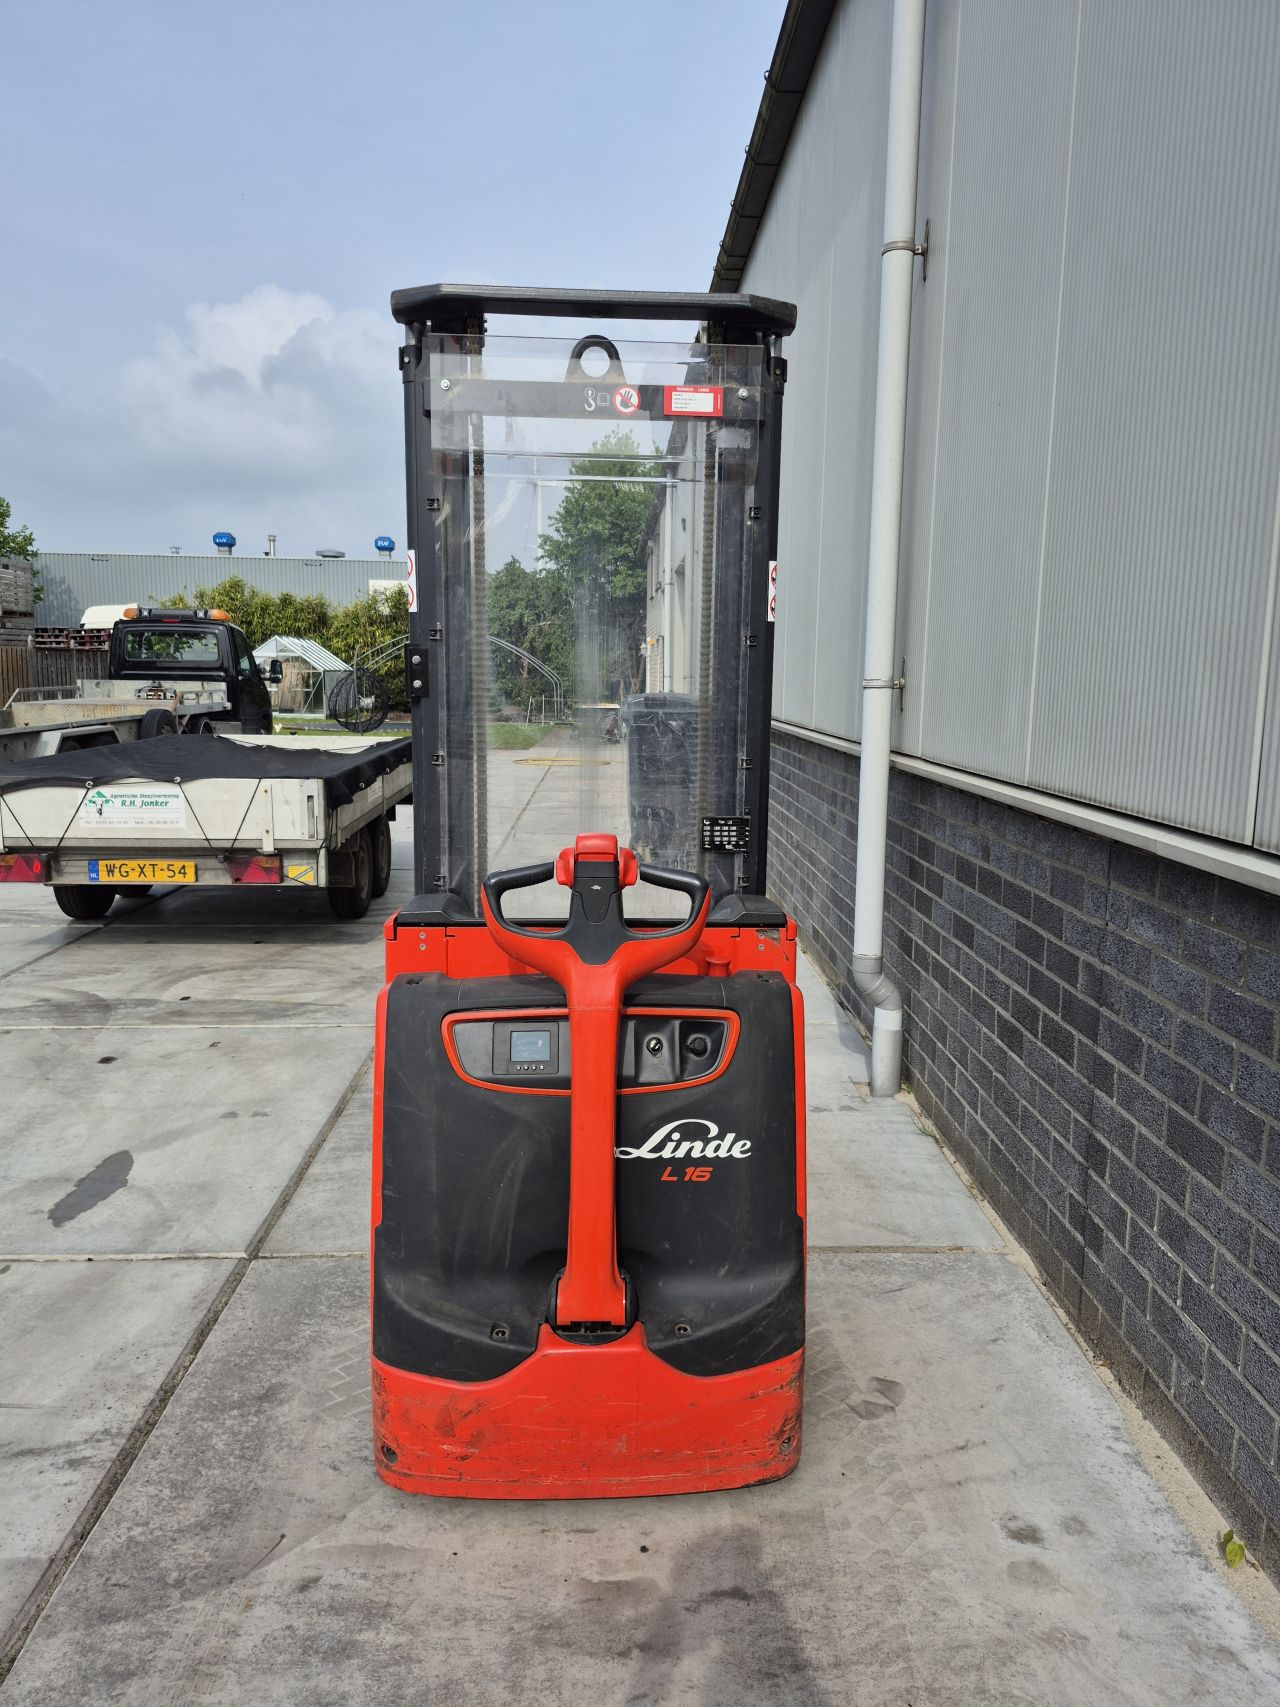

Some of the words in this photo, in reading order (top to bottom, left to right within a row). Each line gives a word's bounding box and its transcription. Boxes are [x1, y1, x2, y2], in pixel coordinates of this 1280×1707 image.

[121, 799, 137, 807] R.H.
[140, 799, 169, 808] Jonker
[105, 863, 188, 879] WG-XT-54
[613, 1118, 752, 1159] Linde
[660, 1166, 678, 1182] L
[683, 1166, 714, 1182] 16
